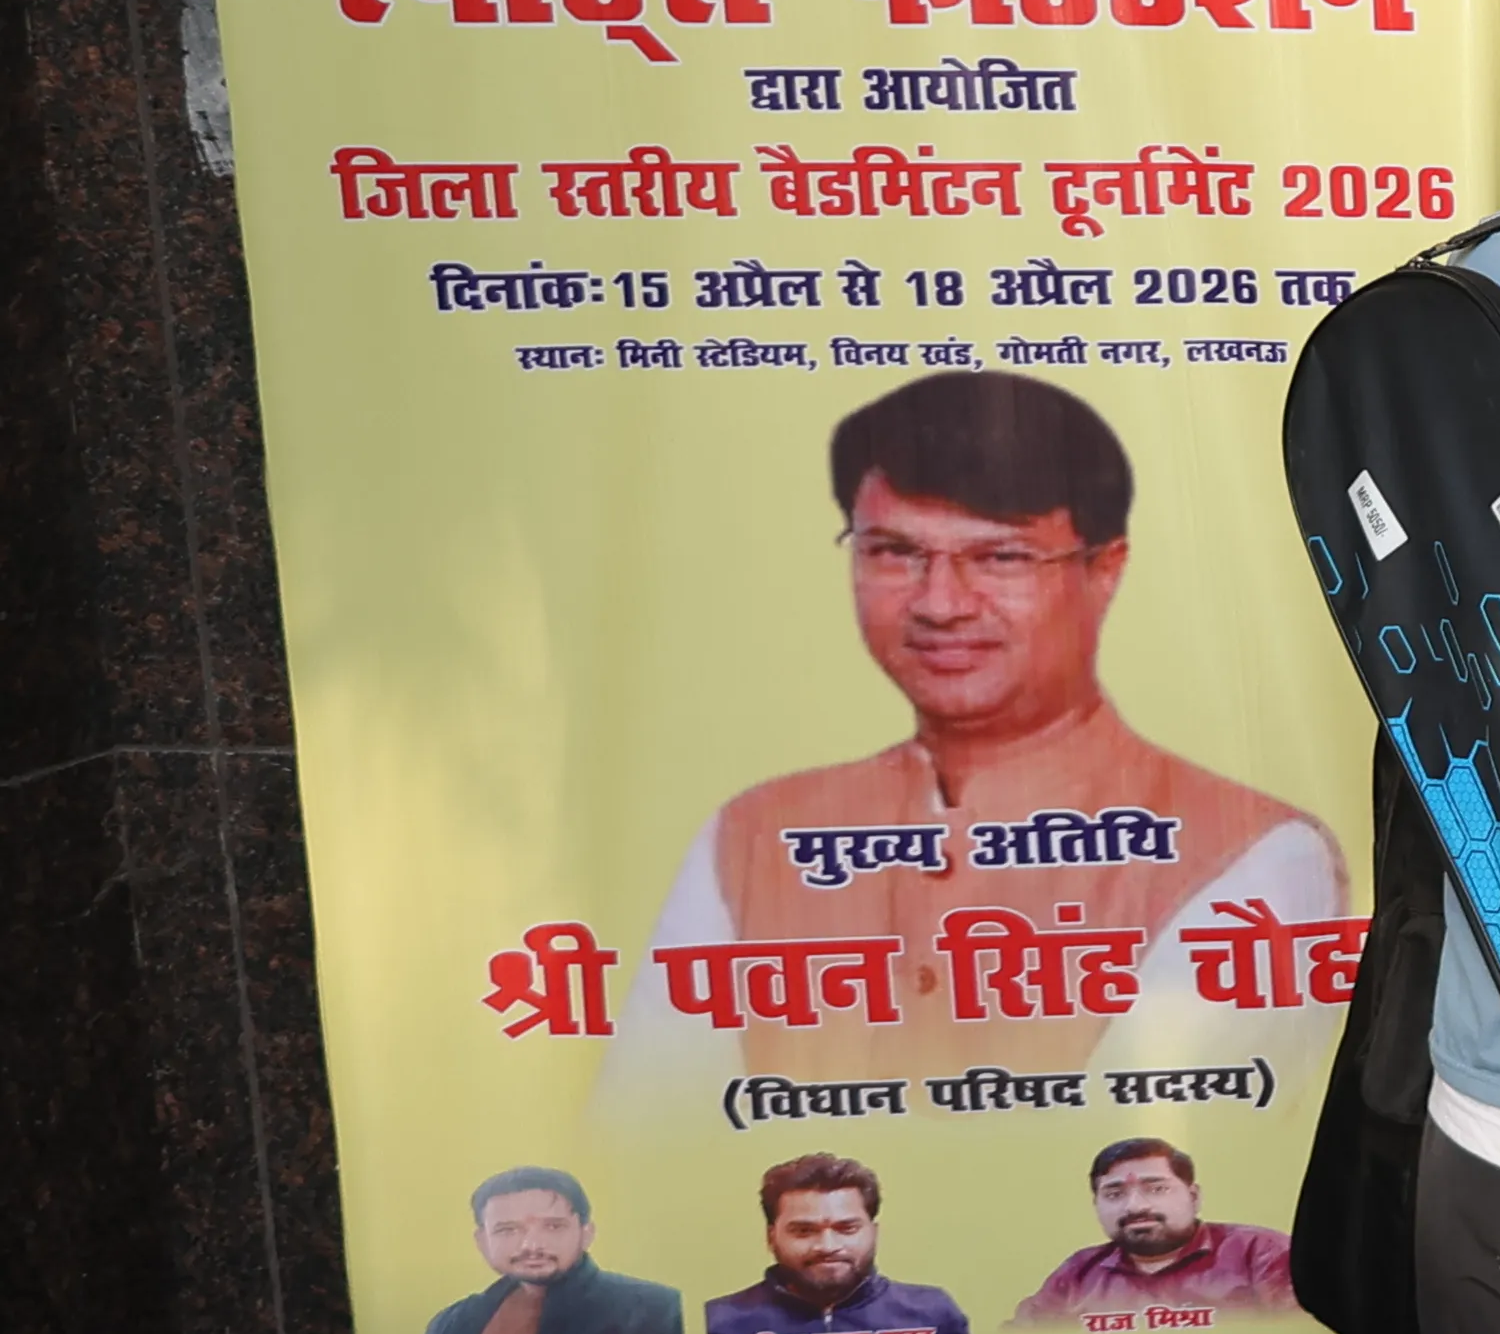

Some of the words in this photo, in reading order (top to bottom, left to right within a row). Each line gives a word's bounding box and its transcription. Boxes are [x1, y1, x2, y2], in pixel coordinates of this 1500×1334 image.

[745, 70, 840, 110] द्वारा
[864, 59, 1074, 110] आयोजित
[332, 148, 516, 218] जिला
[542, 147, 738, 216] स्तरीय
[756, 146, 1021, 215] बैडमिंटन
[1045, 146, 1253, 236] टूर्नामेंट
[1284, 166, 1453, 219] 2026
[695, 260, 820, 307] अप्रैल
[838, 260, 880, 305] से
[908, 272, 962, 305] 18
[992, 259, 1111, 305] अप्रैल
[1135, 270, 1256, 303] 2026
[1270, 267, 1357, 307] तक
[616, 340, 682, 367] मिनी
[696, 339, 815, 370] स्टेडियम,
[831, 338, 907, 365] विनय
[999, 337, 1086, 364] गोमती
[1099, 342, 1169, 366] नगर,
[1188, 341, 1286, 362] लखनऊ
[1356, 485, 1372, 509] MRP
[786, 829, 944, 885] मुख्य
[973, 811, 1175, 865] अतिथि
[484, 924, 616, 1038] श्री
[654, 937, 900, 1028] पवन
[938, 905, 1144, 1019] सिंह
[724, 1078, 905, 1129] (विधान
[926, 1069, 1085, 1111] परिषद
[1105, 1059, 1273, 1107] सदस्य)
[1082, 1312, 1138, 1333] राज
[1144, 1307, 1214, 1330] मिश्रा
